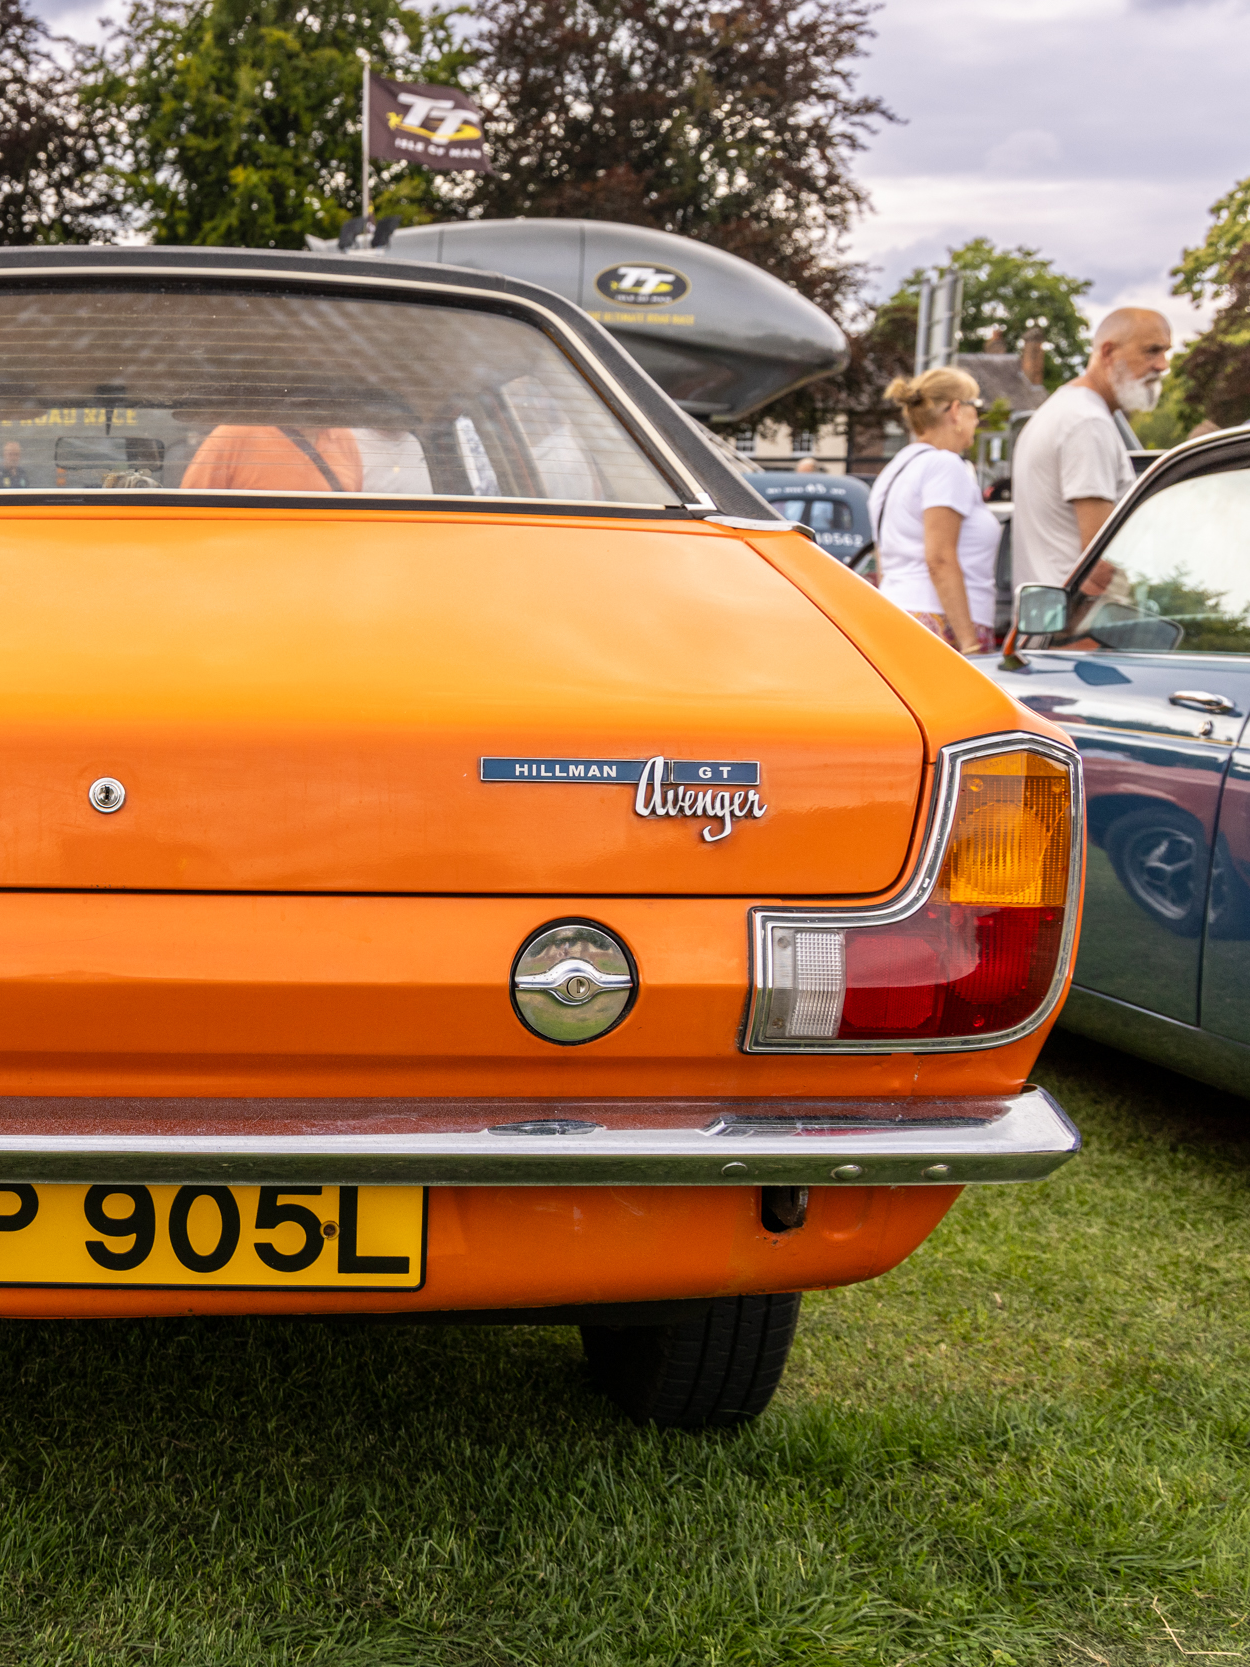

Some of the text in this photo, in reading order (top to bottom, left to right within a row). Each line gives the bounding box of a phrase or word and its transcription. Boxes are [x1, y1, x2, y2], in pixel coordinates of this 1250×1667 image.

[397, 92, 479, 145] TT
[394, 137, 482, 159] ISLE OF MAN
[617, 266, 676, 296] TT
[514, 763, 618, 779] HILLMAN
[635, 755, 768, 843] Avenger
[83, 1184, 411, 1274] 905L
